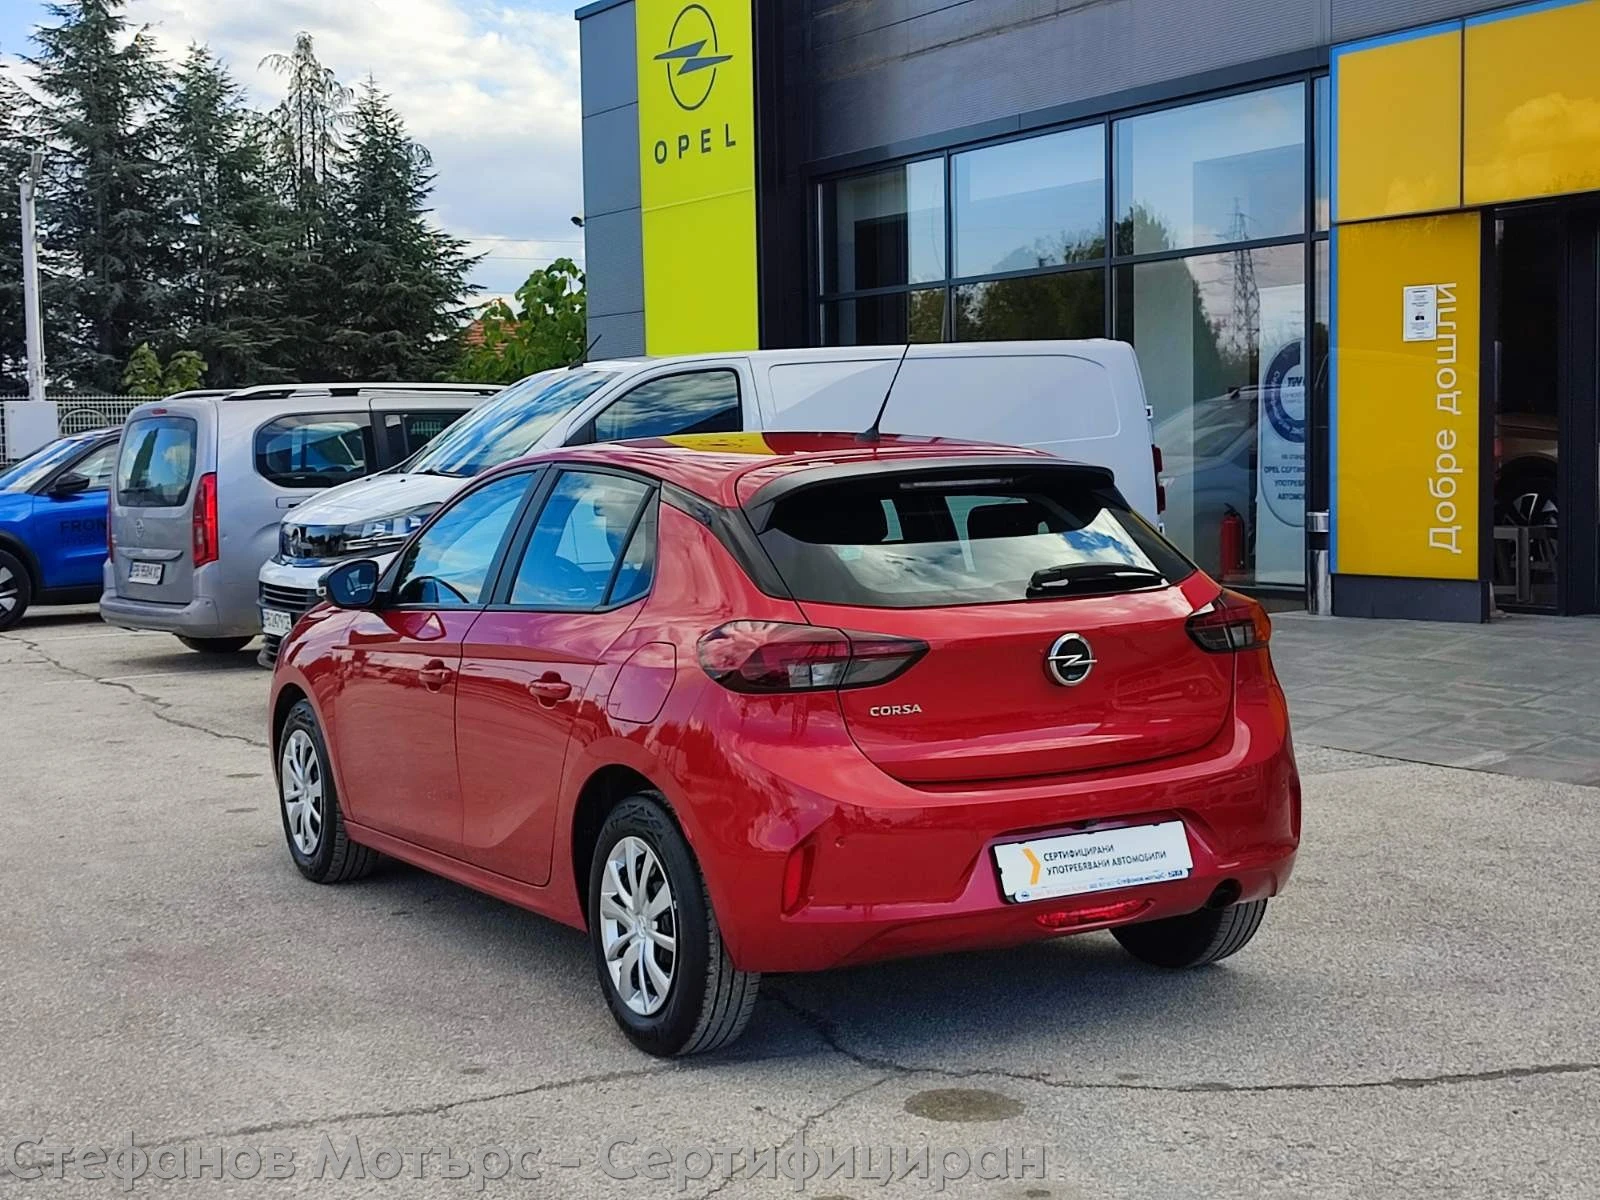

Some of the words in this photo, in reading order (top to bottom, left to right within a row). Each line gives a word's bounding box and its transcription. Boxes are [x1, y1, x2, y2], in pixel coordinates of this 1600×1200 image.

[654, 123, 737, 165] OPEL
[1436, 282, 1462, 415] дошли
[1428, 428, 1464, 554] Добре
[869, 703, 923, 717] CORSA
[1043, 844, 1115, 862] СЕРТИФИЦИРАНИ
[1046, 859, 1110, 876] УПОТРЕБЯВАНИ
[1111, 850, 1168, 868] АВТОМОБИЛИ
